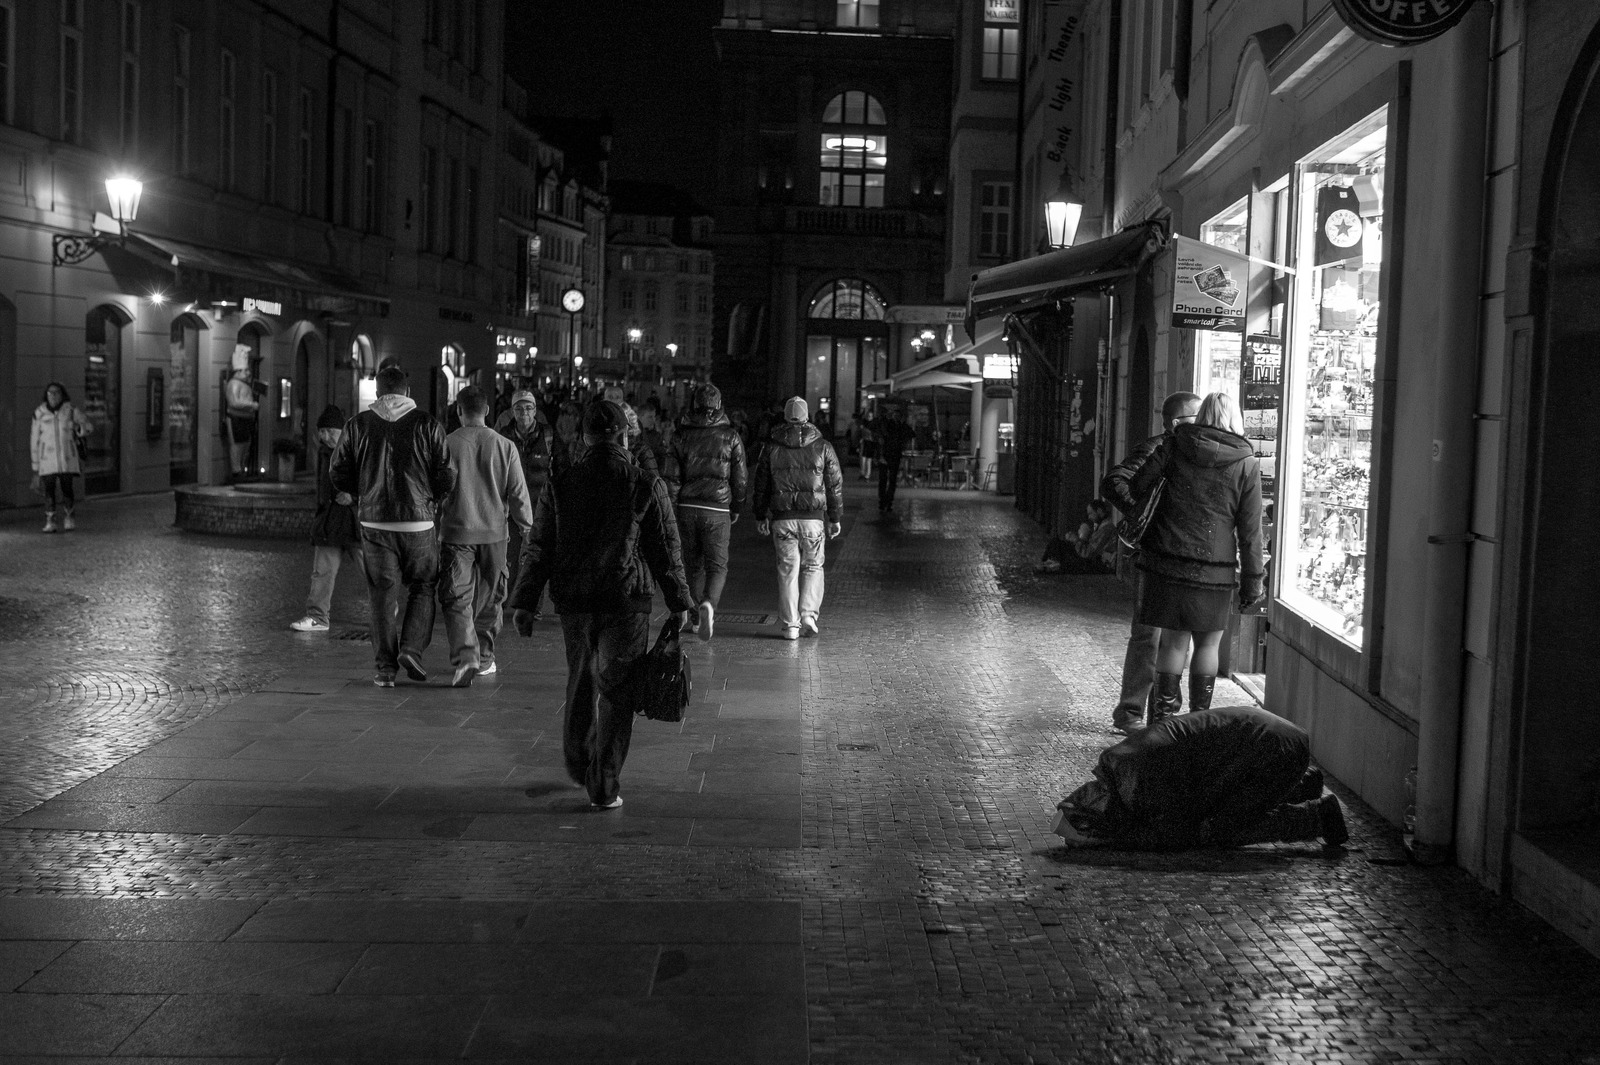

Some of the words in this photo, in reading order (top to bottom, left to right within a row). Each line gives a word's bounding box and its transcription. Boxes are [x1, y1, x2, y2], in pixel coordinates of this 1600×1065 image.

[1048, 16, 1078, 62] Theatre
[1049, 78, 1073, 112] Light
[1047, 126, 1072, 162] Back
[1175, 304, 1212, 314] Phone
[1215, 306, 1243, 316] Card
[1183, 318, 1216, 326] smartcall
